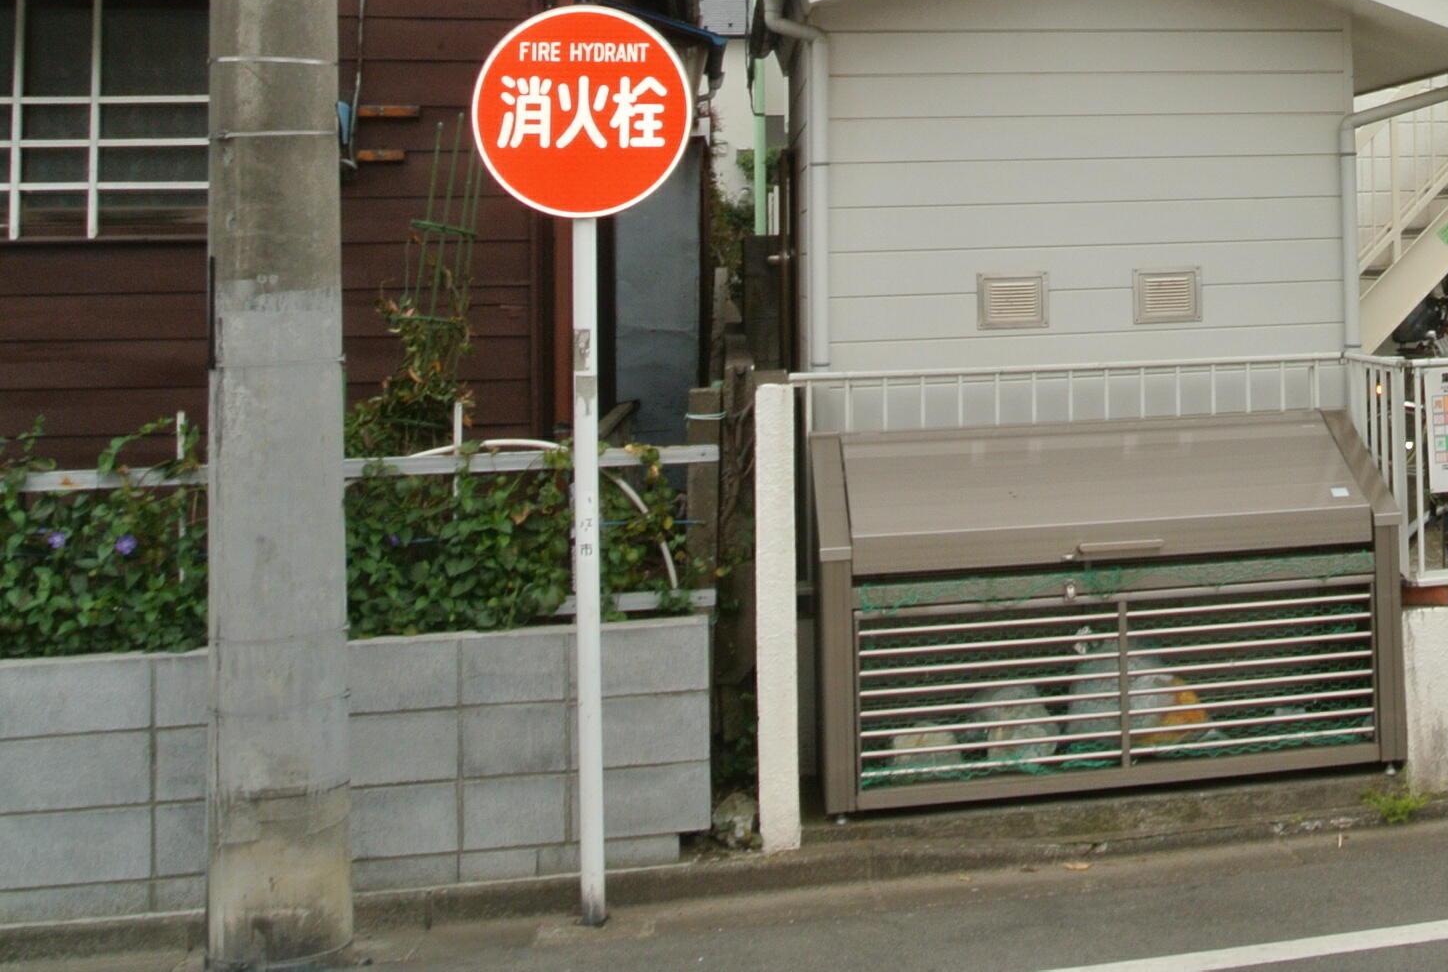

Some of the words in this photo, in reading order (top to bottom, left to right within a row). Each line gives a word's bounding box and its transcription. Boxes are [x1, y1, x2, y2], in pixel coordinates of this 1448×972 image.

[519, 41, 562, 62] FIRE
[570, 42, 650, 62] HYDRANT
[496, 74, 668, 149] 消火栓
